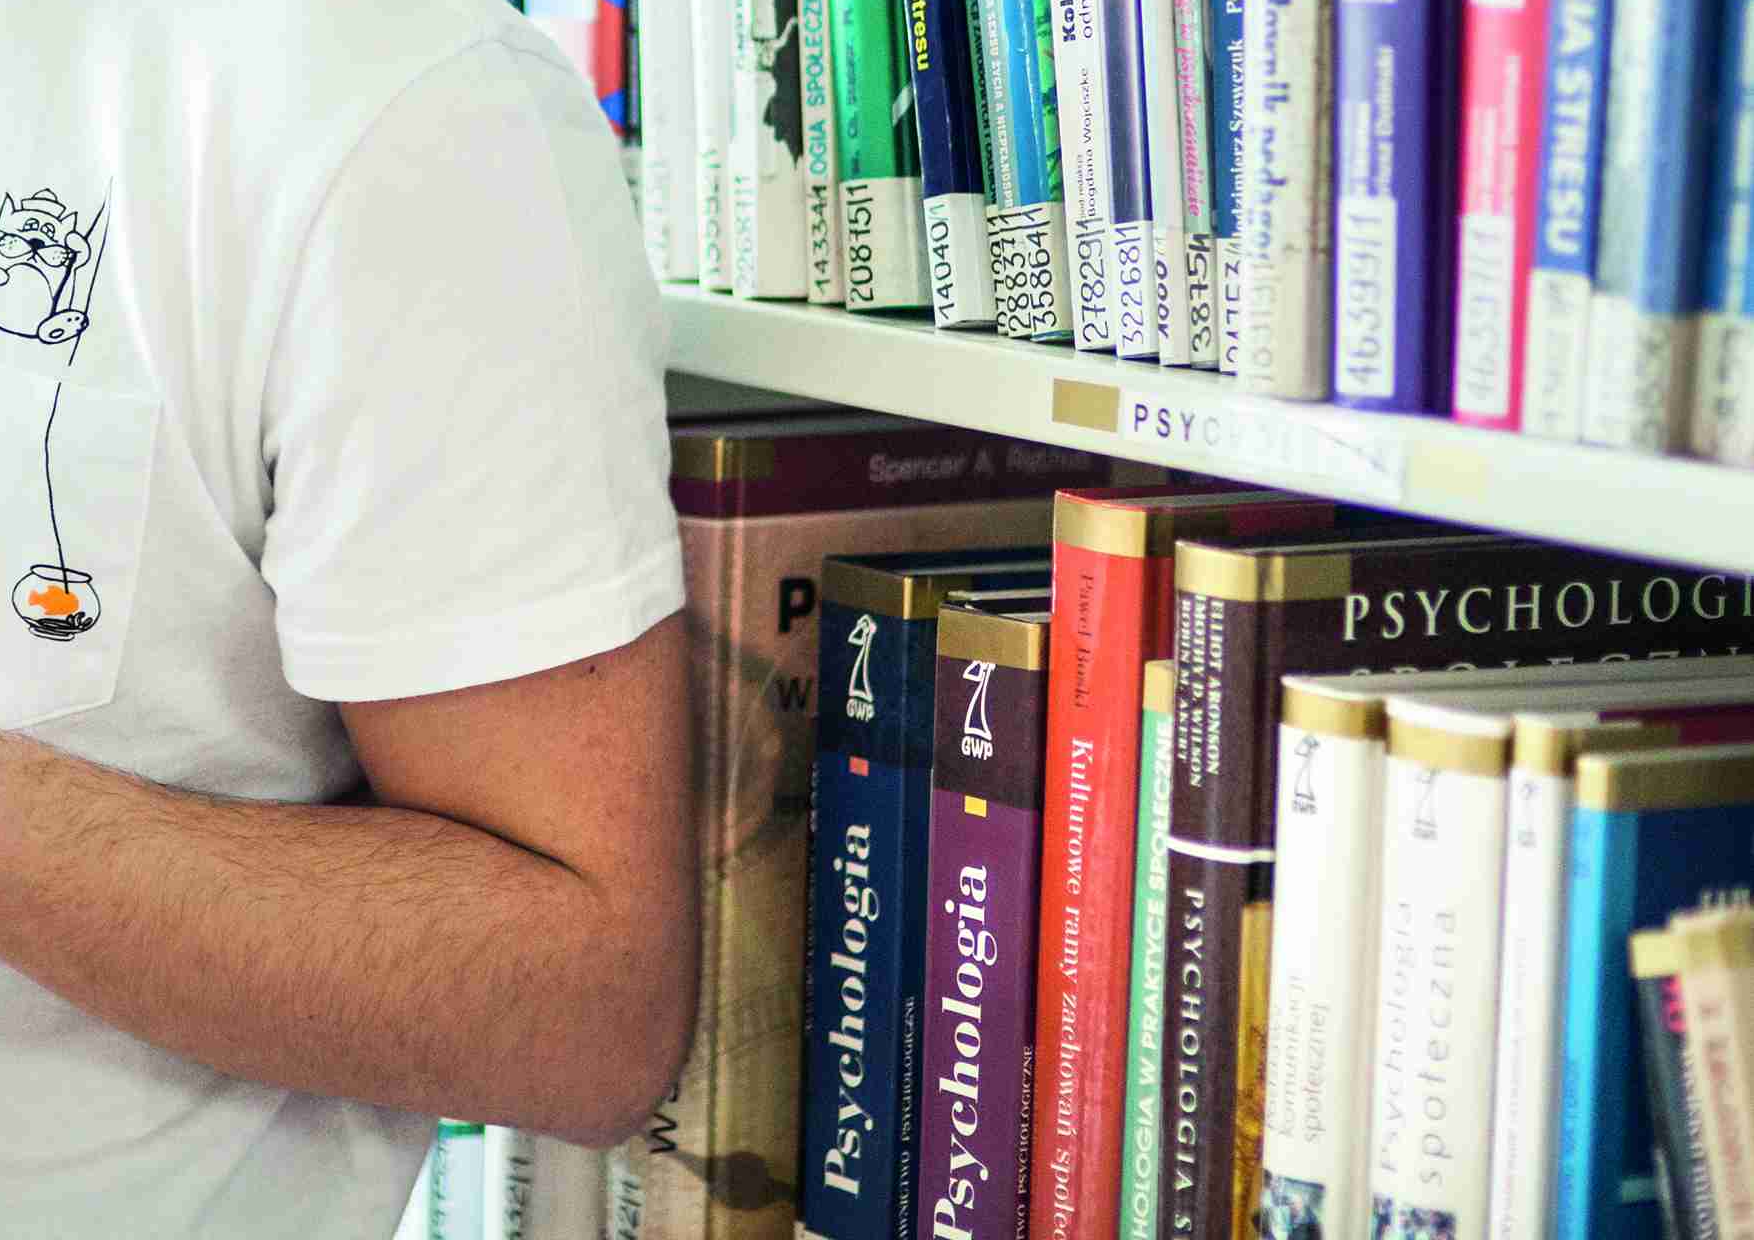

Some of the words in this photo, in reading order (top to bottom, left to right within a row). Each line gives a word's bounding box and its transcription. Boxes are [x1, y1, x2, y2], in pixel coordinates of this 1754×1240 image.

[1547, 66, 1594, 254] STRESU
[869, 450, 965, 485] Spencer
[1208, 600, 1226, 671] ELLIOT
[961, 735, 994, 761] GWP
[1189, 706, 1205, 788] WILSON
[1205, 675, 1222, 776] ARONSON
[1064, 736, 1096, 897] Kulturowe
[1146, 721, 1173, 893] SPOŁECZNE
[823, 823, 881, 1200] Psychologia
[1058, 905, 1083, 984] ramy
[1139, 898, 1164, 1050] PRAKTYCE
[899, 995, 918, 1143] PSYCHOLOGICZNE
[931, 864, 998, 1240] Psychologia
[1052, 992, 1083, 1137] zachowań
[1136, 1055, 1156, 1086] W
[1173, 887, 1205, 1193] PSYCHOLOGIA
[1411, 909, 1458, 1187] społeczna
[1015, 1045, 1034, 1195] PSYCHOLOGICZNE
